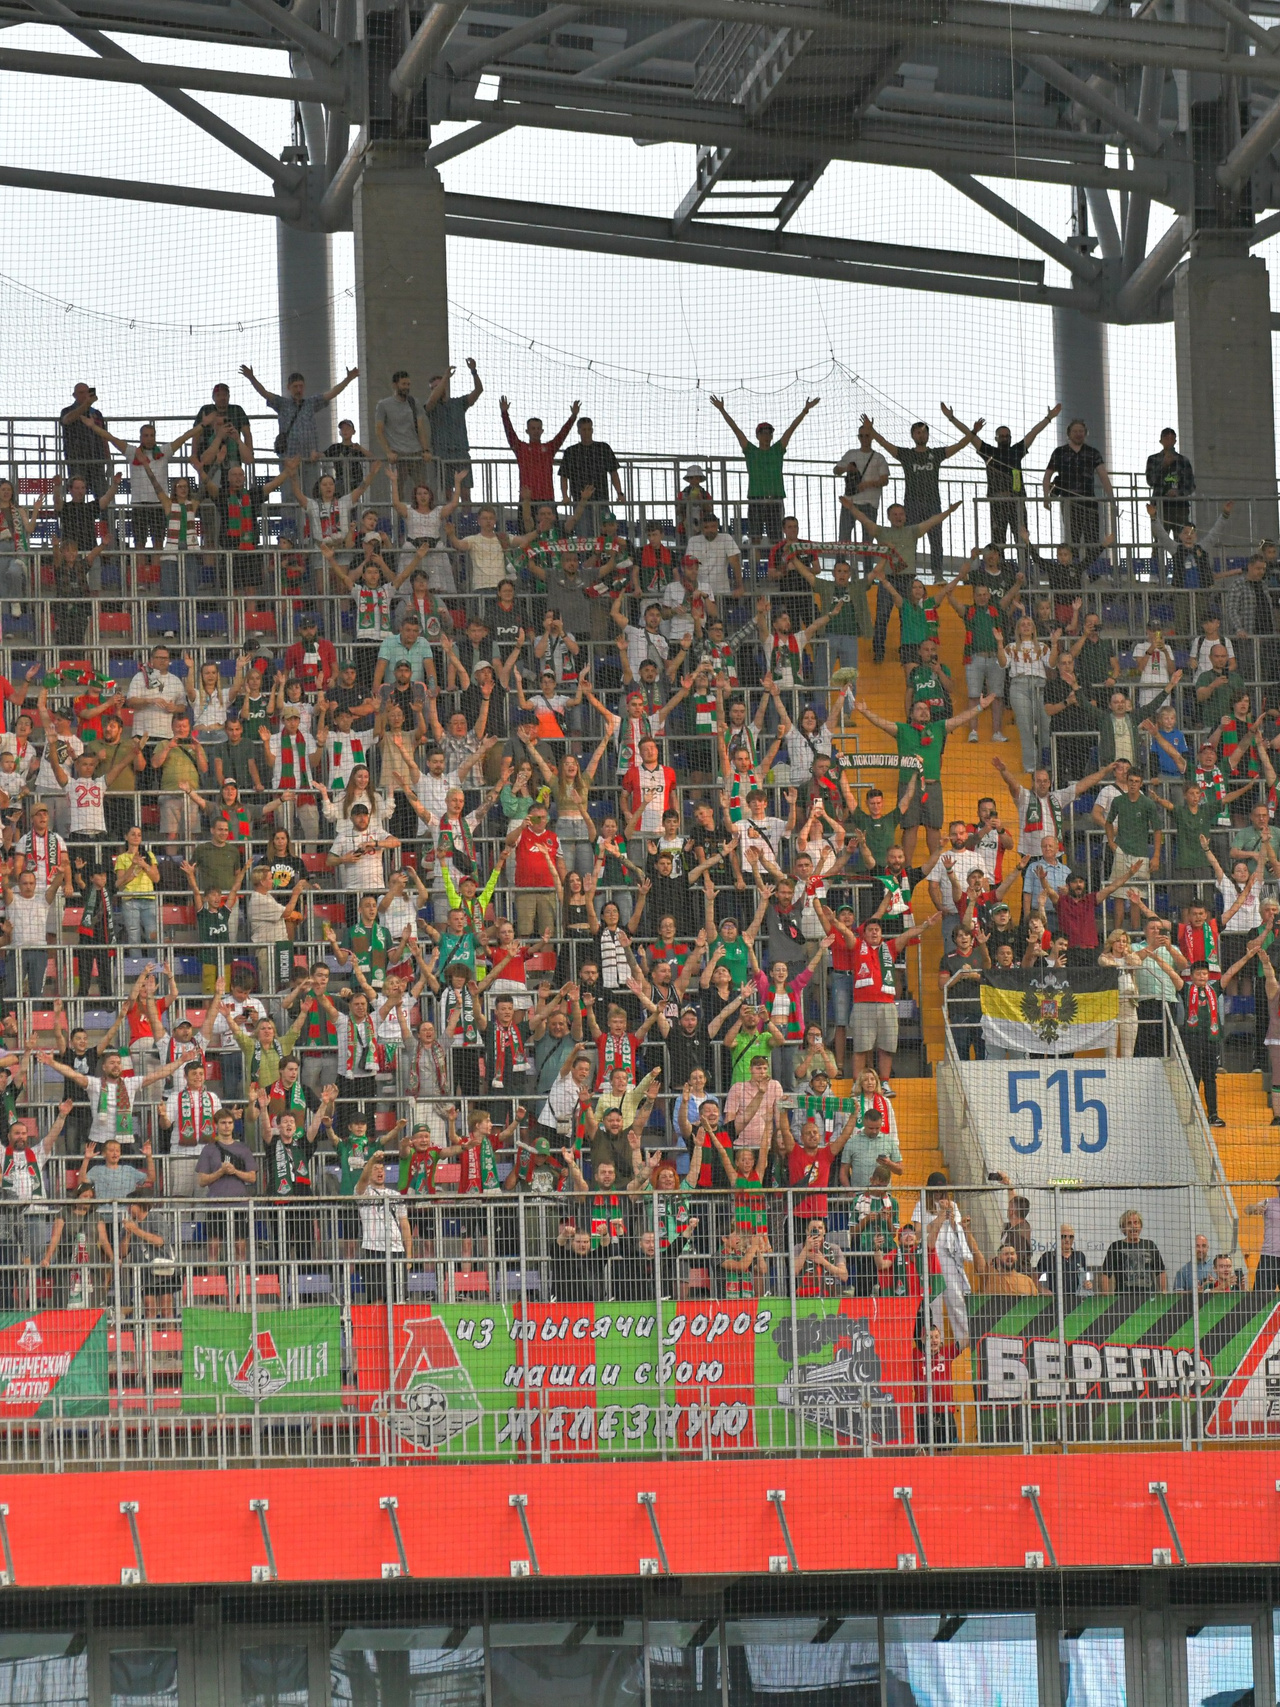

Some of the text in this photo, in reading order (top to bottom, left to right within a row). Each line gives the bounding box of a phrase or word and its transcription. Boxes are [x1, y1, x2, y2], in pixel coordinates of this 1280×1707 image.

[853, 756, 898, 768] ЛОКОМОТИВ
[76, 784, 101, 808] 29
[1008, 1069, 1108, 1154] 515
[456, 1309, 772, 1349] из тысячи дорог
[504, 1351, 724, 1389] нашли свою
[985, 1336, 1212, 1400] БЕРЕГИСЬ
[6, 1382, 50, 1404] СЕКТОР
[499, 1402, 750, 1444] ЖЕЛЕЗНУЮ
